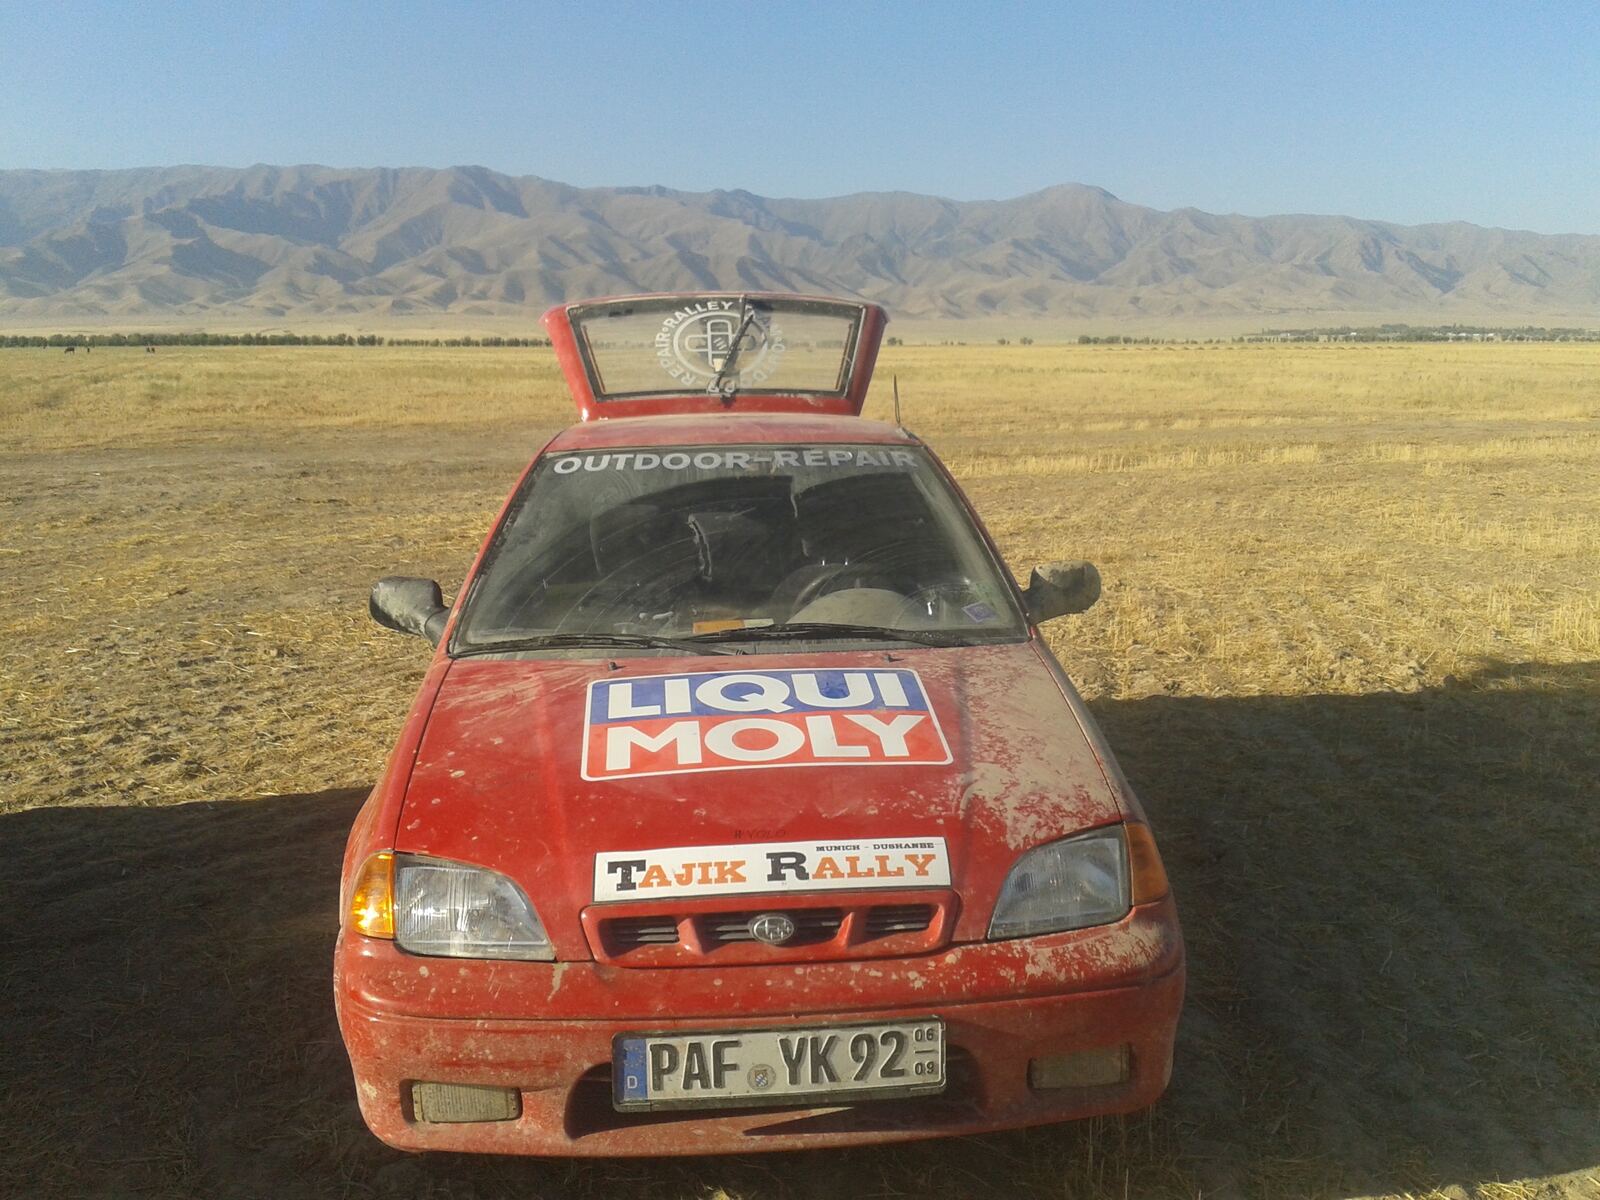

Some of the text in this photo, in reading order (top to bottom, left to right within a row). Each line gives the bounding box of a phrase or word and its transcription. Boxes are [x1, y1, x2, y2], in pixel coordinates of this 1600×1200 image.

[666, 301, 734, 328] RALLEY
[655, 332, 697, 386] REPAIR
[553, 450, 919, 475] OUTDOOR-REPAIR
[608, 673, 910, 719] LIQUI
[605, 714, 926, 771] MOLY
[815, 844, 860, 852] MUNICH
[873, 842, 935, 850] DUSHANBE
[607, 851, 936, 892] TAJIK RALLY
[914, 1028, 935, 1042] 06
[649, 1040, 743, 1091] PAF
[914, 1061, 935, 1076] 09
[626, 1075, 638, 1089] D
